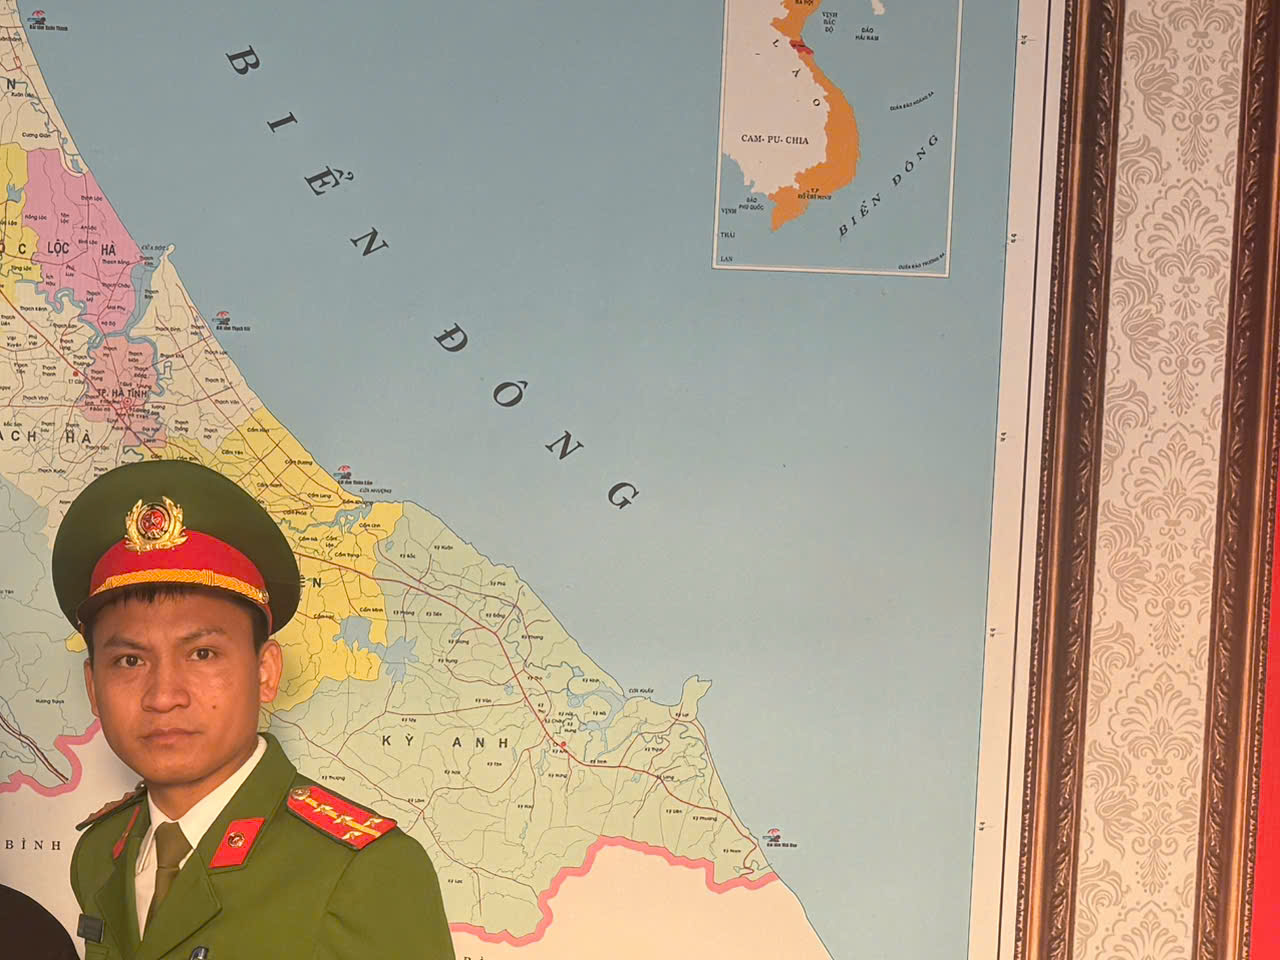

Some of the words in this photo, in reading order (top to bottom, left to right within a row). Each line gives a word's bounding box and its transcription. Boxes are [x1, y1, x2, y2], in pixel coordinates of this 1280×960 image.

[786, 137, 809, 145] CHIA
[47, 239, 69, 257] LỘC
[101, 241, 116, 256] HÀ
[224, 44, 390, 258] BIỂN
[433, 321, 640, 510] ĐÔNG
[382, 733, 413, 746] KỲ
[452, 737, 508, 748] ANH
[5, 837, 61, 851] BÌNH
